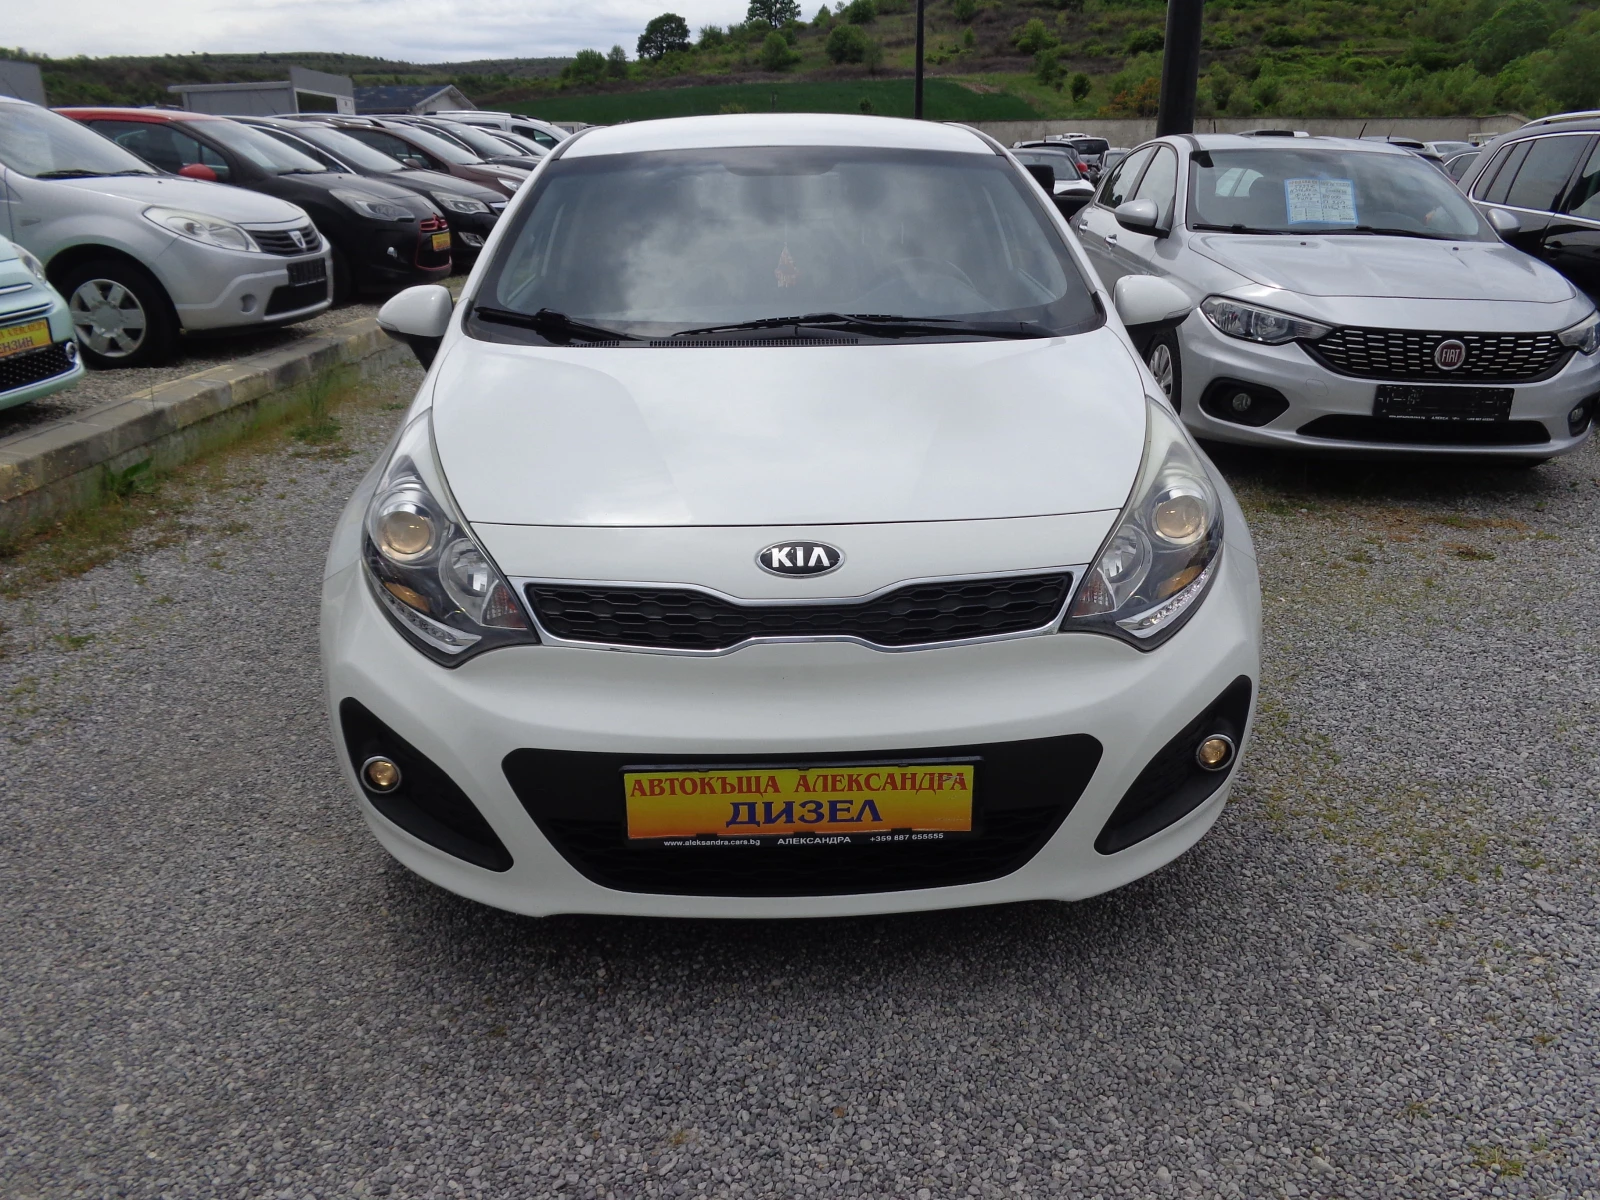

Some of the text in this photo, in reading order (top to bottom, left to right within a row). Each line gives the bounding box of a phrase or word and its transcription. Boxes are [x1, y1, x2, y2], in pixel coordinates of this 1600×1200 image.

[1441, 349, 1460, 362] FIAT
[771, 546, 831, 568] KIA
[630, 771, 968, 798] АВТОКЪЩА АЛЕКСАНДРА
[725, 799, 883, 828] ДИЗЕЛ
[777, 836, 852, 845] АЛЕКСАНДРА
[869, 835, 892, 843] +359
